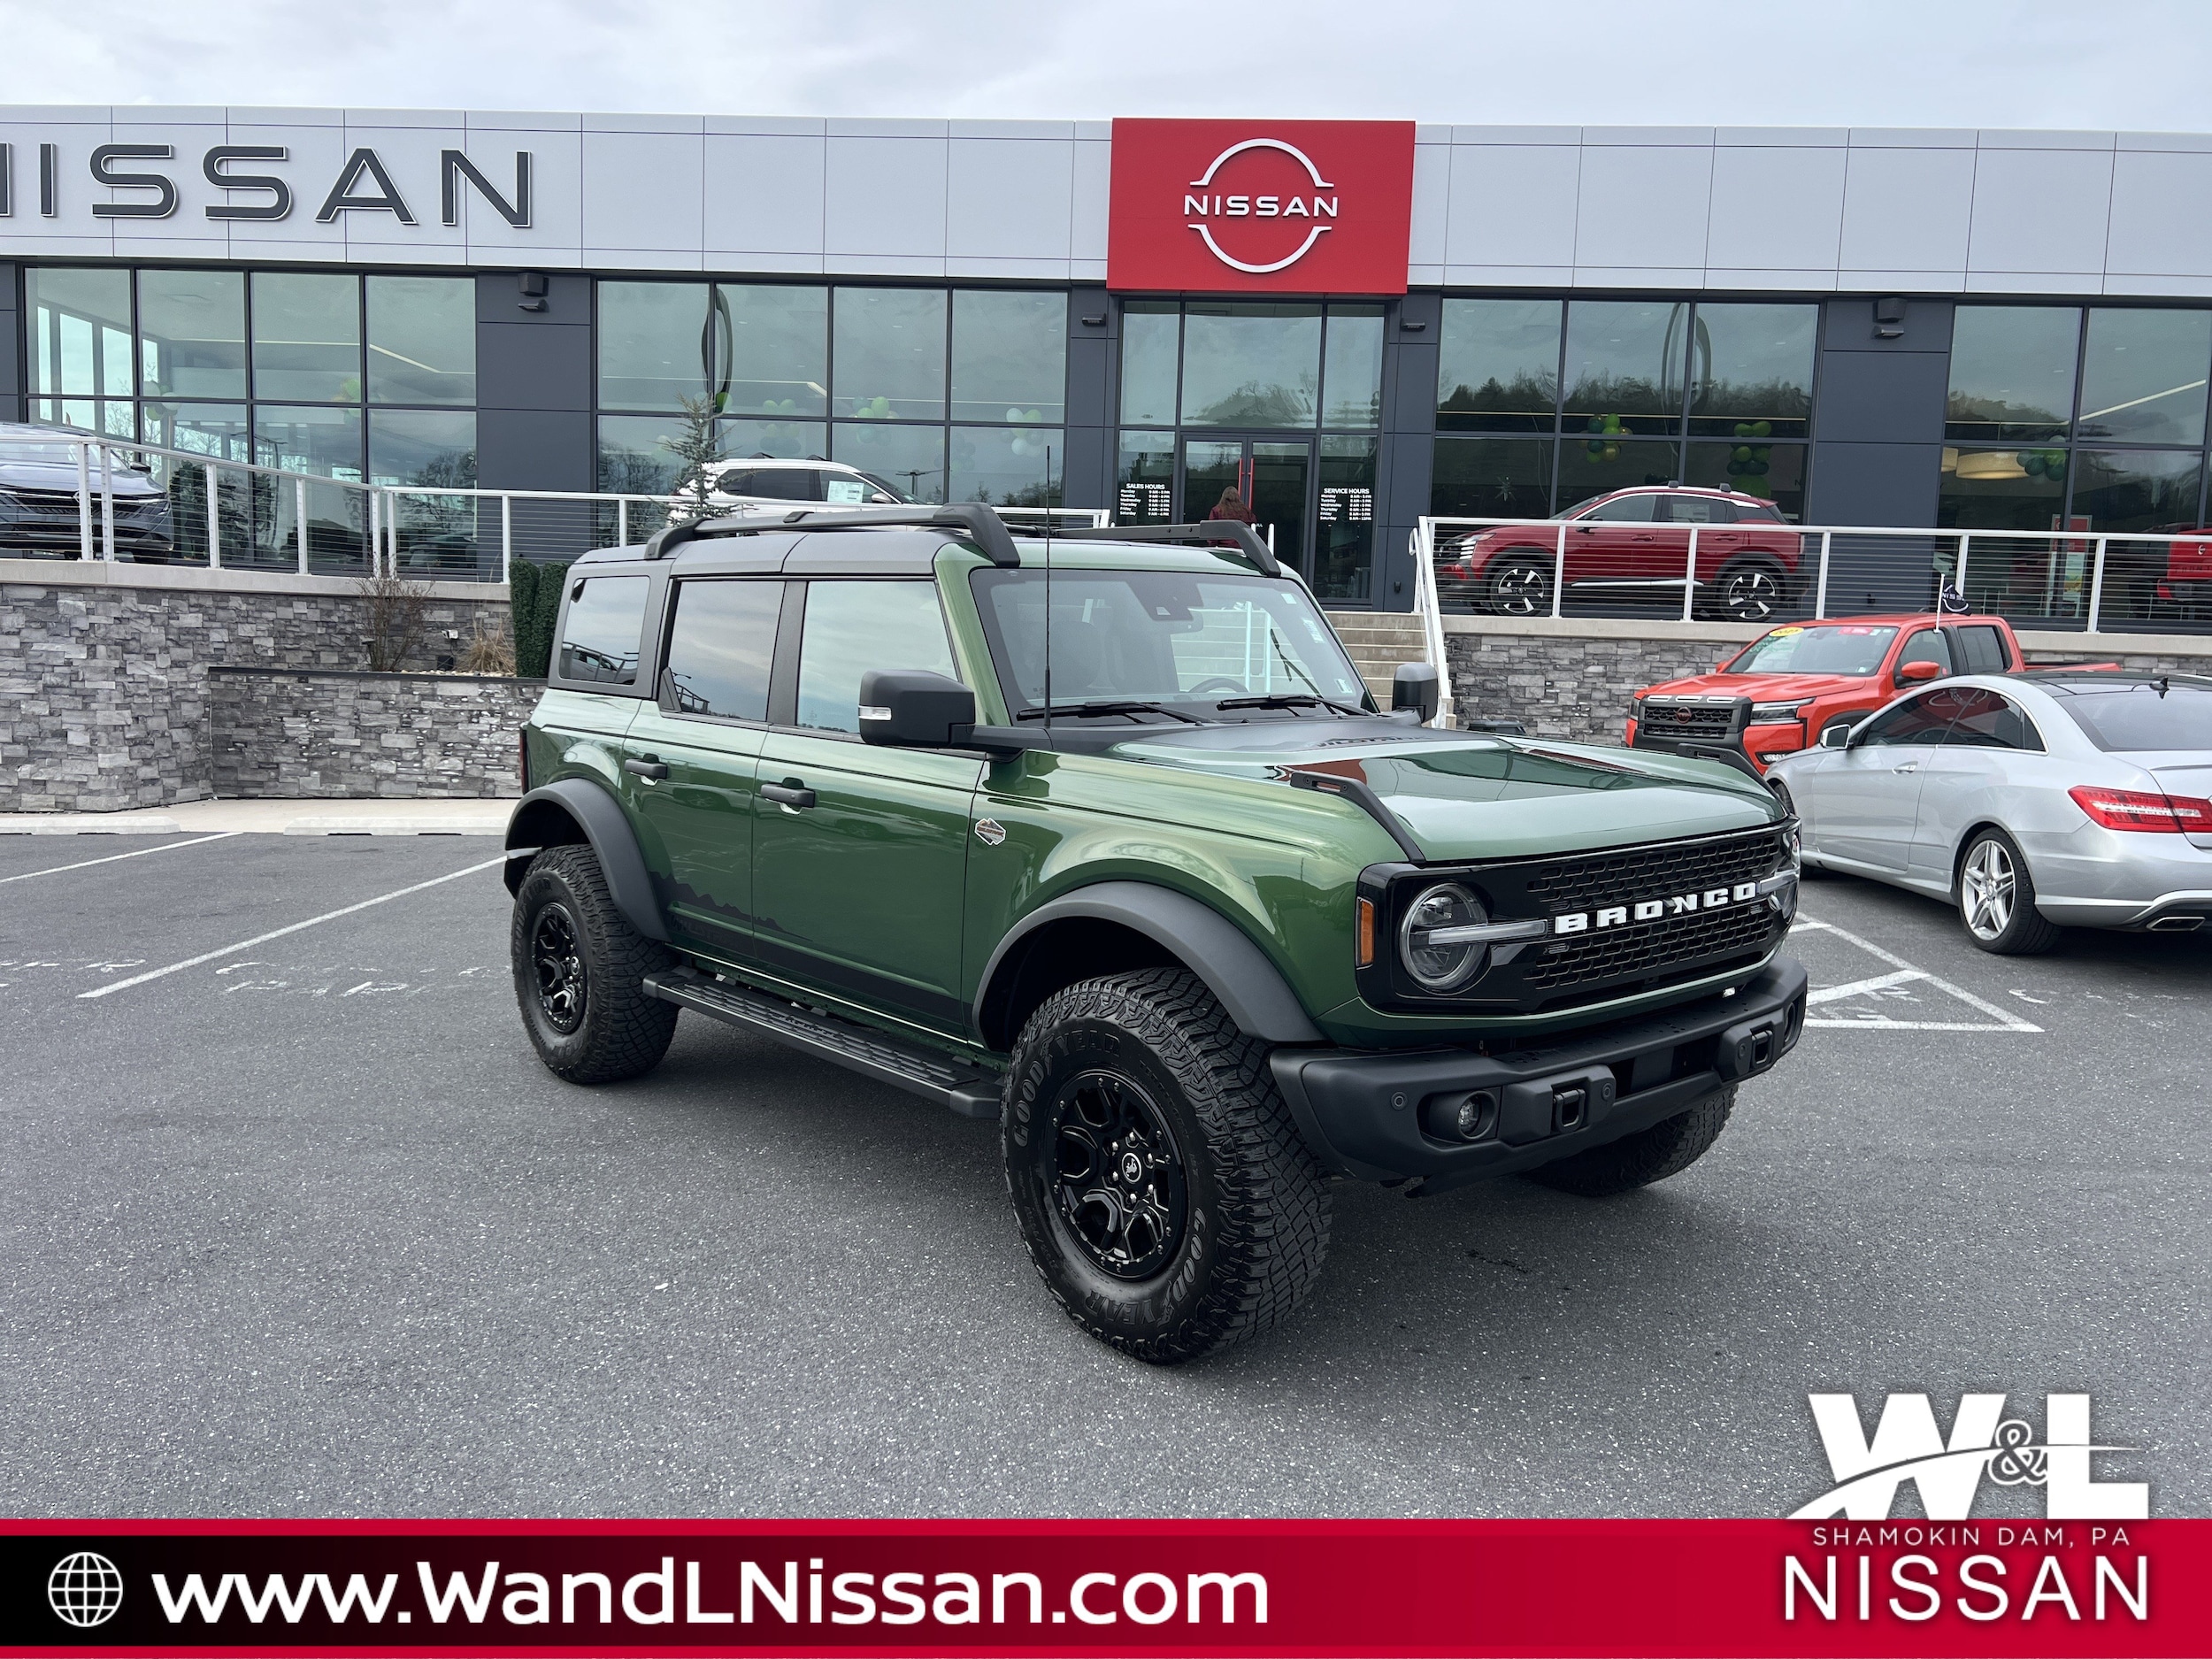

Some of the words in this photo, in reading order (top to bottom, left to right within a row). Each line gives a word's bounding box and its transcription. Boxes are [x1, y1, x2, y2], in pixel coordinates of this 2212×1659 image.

[0, 142, 532, 227] ISSAN
[1184, 194, 1339, 218] NISSAN
[1555, 882, 1756, 933] BRONCO
